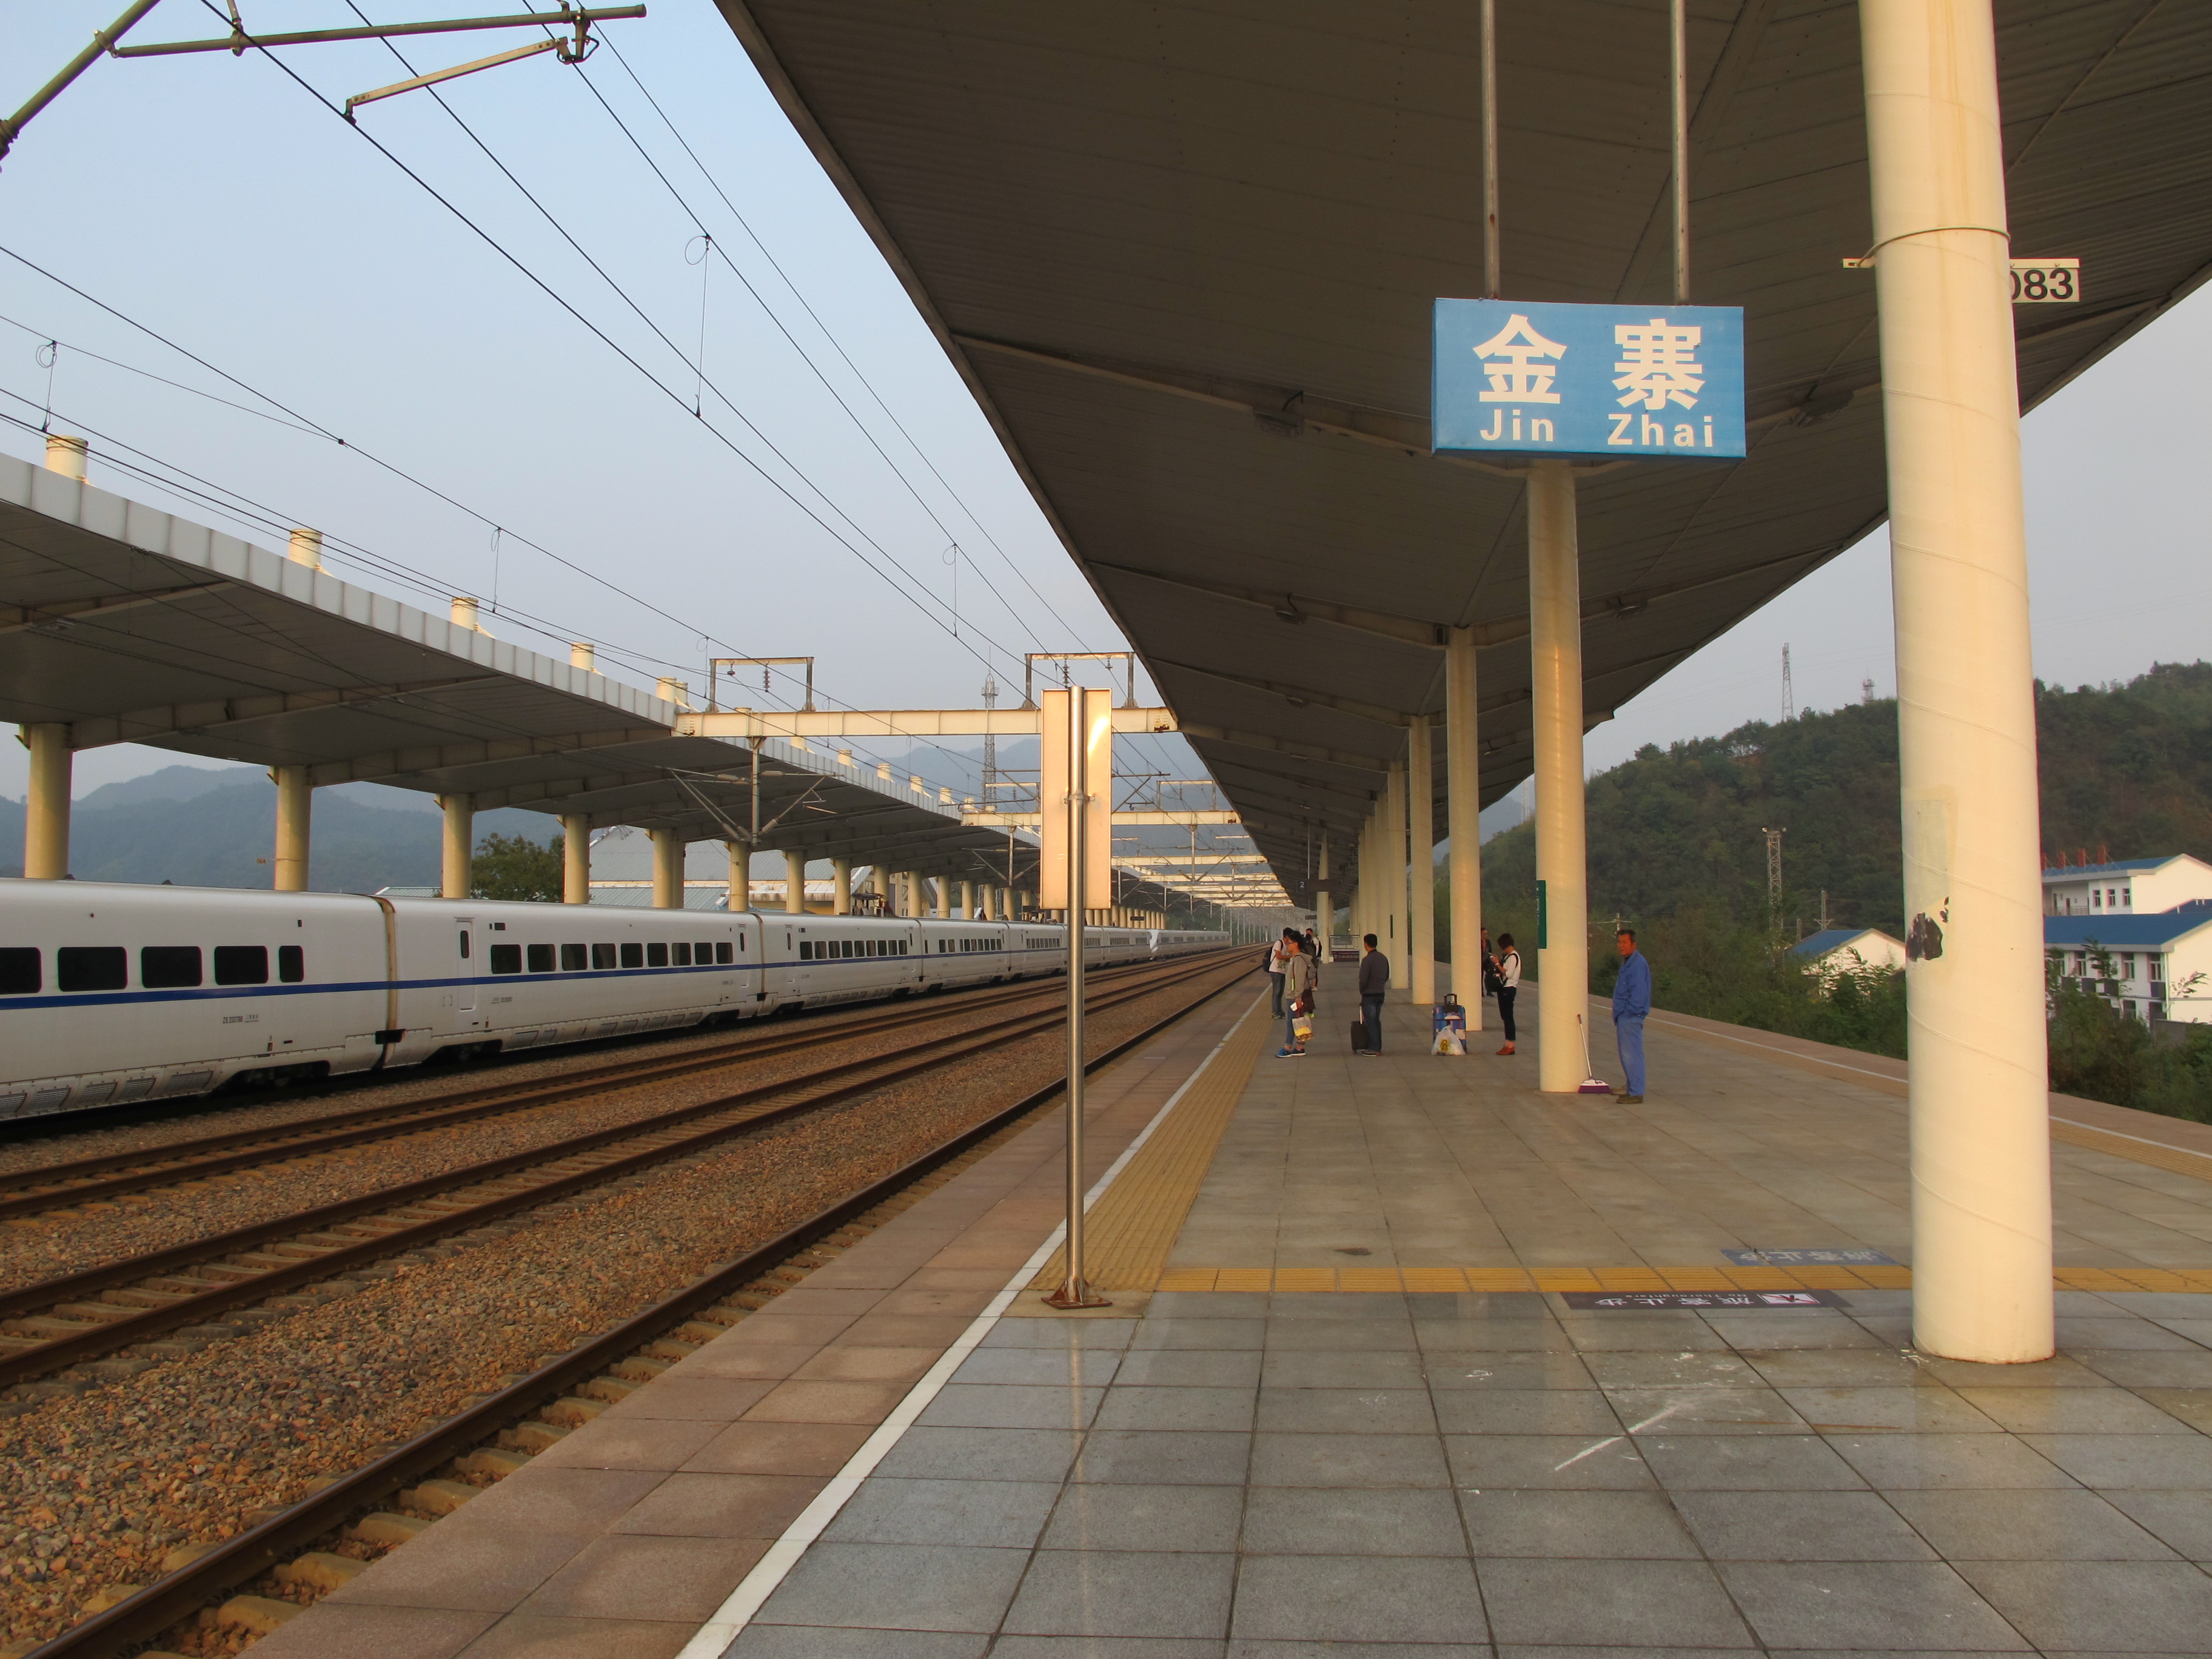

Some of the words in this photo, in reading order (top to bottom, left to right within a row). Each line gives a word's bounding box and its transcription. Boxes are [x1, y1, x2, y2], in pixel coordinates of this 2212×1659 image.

[1472, 313, 1705, 410] 金寨
[1480, 409, 1554, 441] Jin
[1607, 414, 1713, 447] Zhai
[1595, 1297, 1754, 1305] 旅客止步
